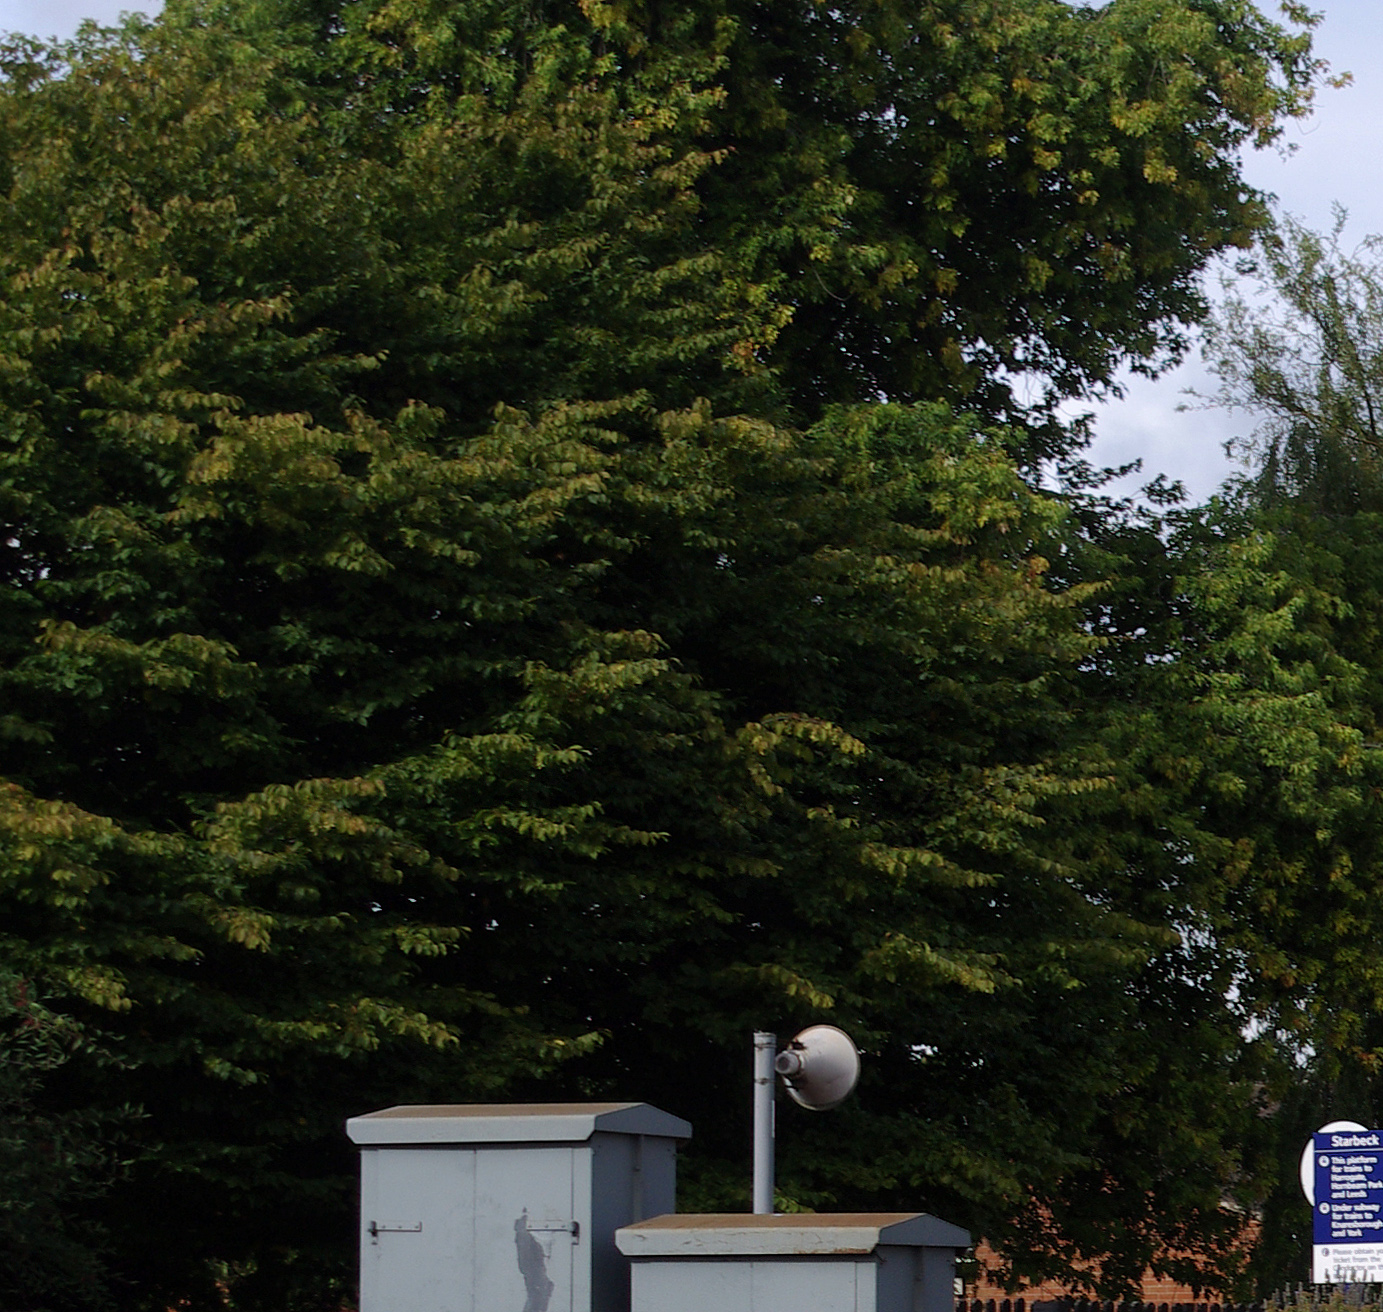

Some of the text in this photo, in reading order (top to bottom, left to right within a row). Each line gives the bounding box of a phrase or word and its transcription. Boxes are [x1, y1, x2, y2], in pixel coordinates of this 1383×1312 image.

[1331, 1134, 1380, 1147] Starbeck
[1331, 1156, 1378, 1166] This platform
[1331, 1165, 1343, 1173] for
[1344, 1165, 1363, 1173] trains
[1368, 1181, 1383, 1189] Park
[1331, 1190, 1368, 1198] and Leeds
[1331, 1203, 1380, 1212] Under subway
[1332, 1212, 1374, 1220] for trains to
[1331, 1229, 1363, 1237] and York
[1353, 1247, 1375, 1255] obtain
